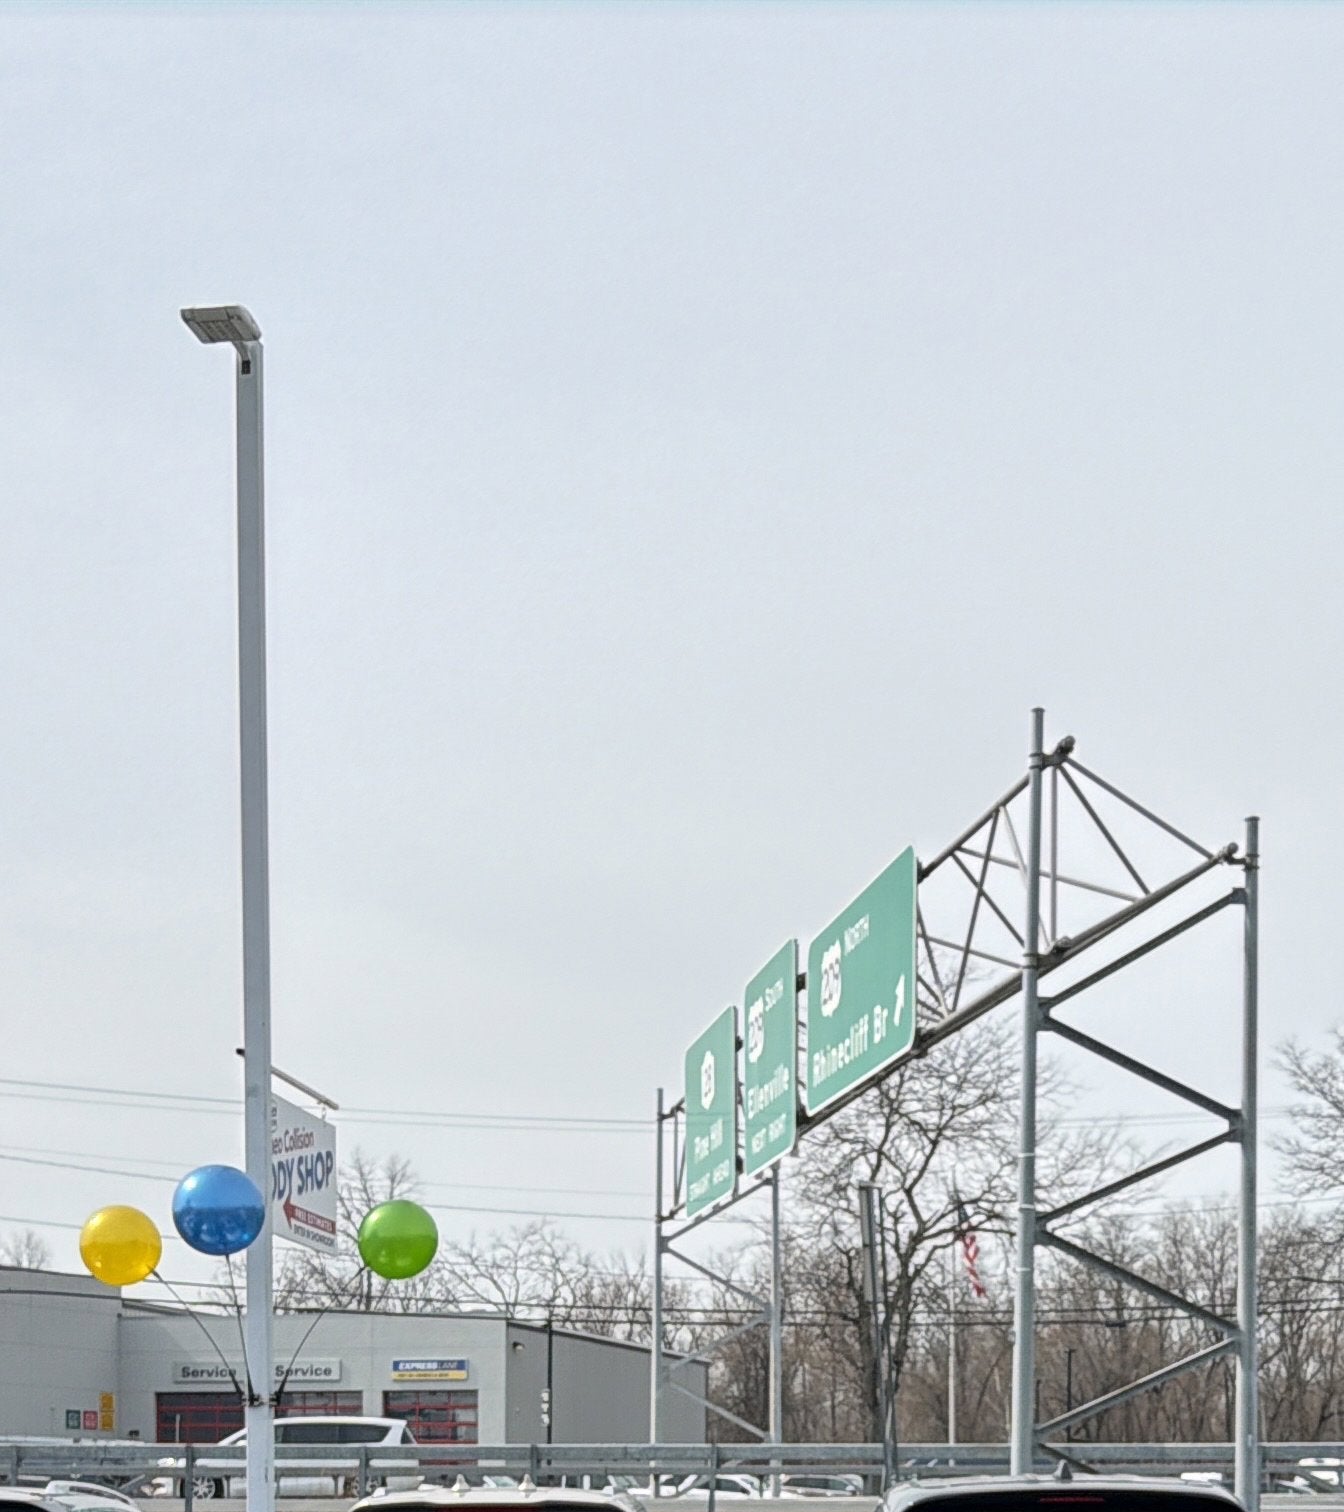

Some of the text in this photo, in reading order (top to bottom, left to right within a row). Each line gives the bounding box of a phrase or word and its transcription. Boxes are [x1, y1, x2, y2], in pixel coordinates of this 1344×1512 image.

[812, 1004, 889, 1088] Rhinecliff Br
[747, 1063, 790, 1120] Ellenville
[284, 1125, 314, 1152] Collision
[297, 1150, 334, 1196] SHOP
[181, 1366, 237, 1378] Service
[275, 1364, 333, 1377] Service
